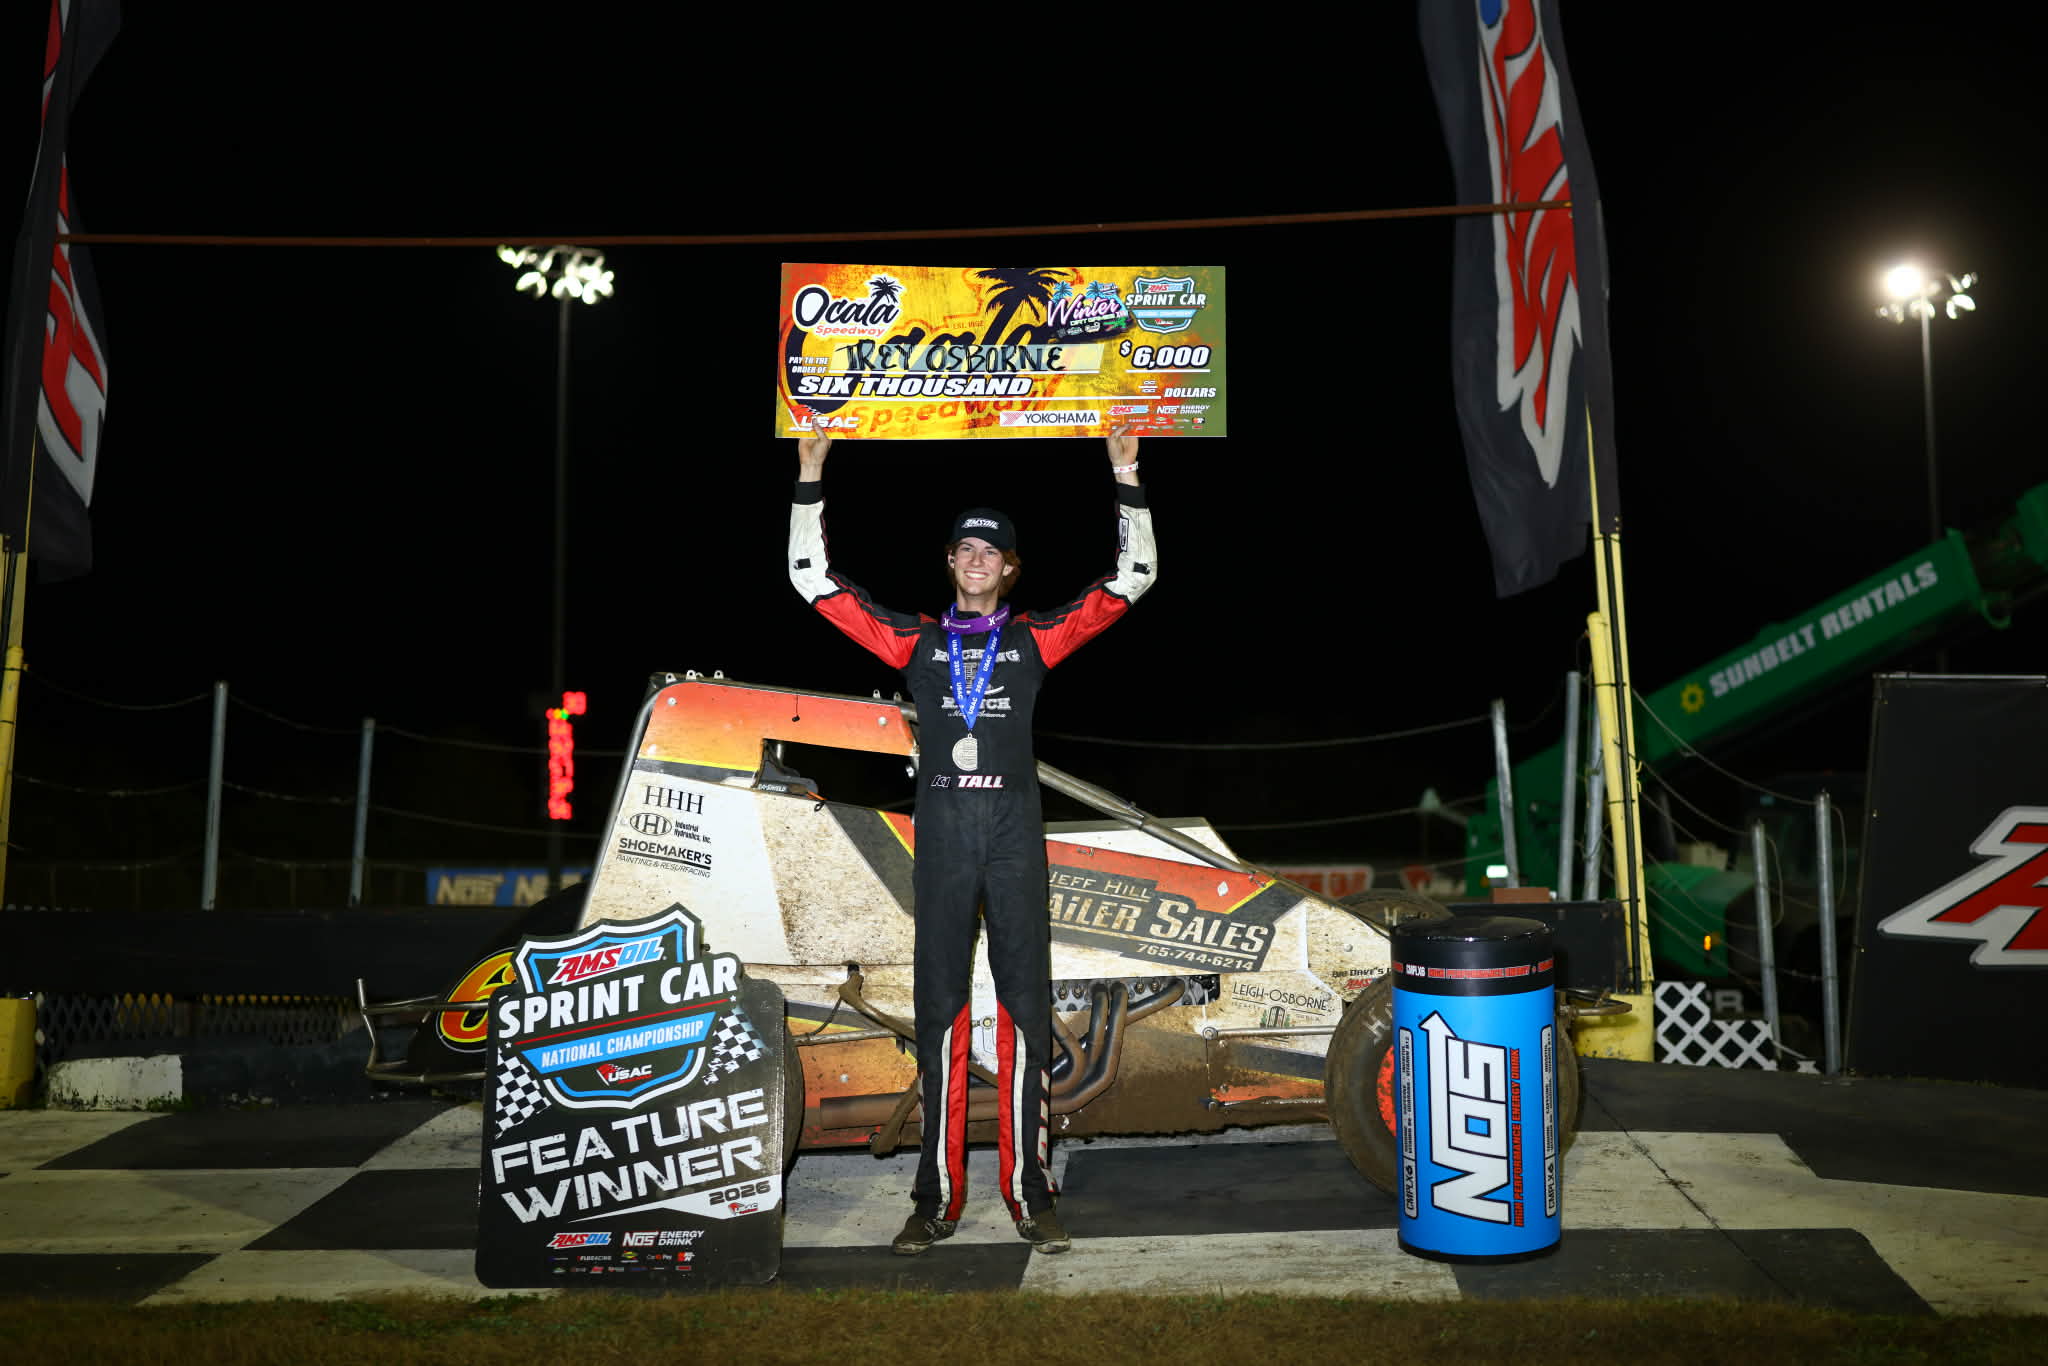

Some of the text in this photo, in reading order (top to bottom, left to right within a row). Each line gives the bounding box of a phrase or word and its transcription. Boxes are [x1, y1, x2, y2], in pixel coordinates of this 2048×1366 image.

[795, 286, 900, 327] Ocala
[1047, 293, 1120, 327] Winter
[1126, 293, 1206, 306] SPRINT CAR
[815, 324, 886, 337] Speedway
[834, 338, 1066, 374] TREY OSBORNE
[817, 366, 828, 374] OF
[797, 375, 1033, 397] SIX THOUSAND
[1163, 387, 1217, 398] DOLLARS
[1024, 412, 1097, 424] YOKOHAMA
[1156, 405, 1180, 414] NOS
[1709, 561, 1939, 698] SUNBELT RENTALS
[957, 775, 1004, 789] TALL
[642, 785, 705, 815] HHH
[675, 820, 699, 832] Industrial
[618, 837, 712, 866] SHOEMAKER'S
[615, 854, 652, 867] PAINTING
[659, 862, 711, 879] RESURFACING
[1049, 871, 1097, 889] JEFF
[548, 935, 664, 986] AMSOIL
[498, 956, 739, 1040] SPRINT CAR
[1231, 980, 1330, 1011] LEIGH-OSBORNE
[540, 1019, 704, 1069] NATIONAL CHAMPIONSHIP
[607, 1064, 653, 1082] USAC
[1418, 1010, 1513, 1226] NOS
[491, 1087, 769, 1184] FEATURE
[1509, 1047, 1525, 1228] HIGH PERFORMANCE ENERGY DRINK
[501, 1135, 765, 1224] WINNER
[708, 1180, 771, 1206] 2026
[546, 1231, 613, 1249] AMSOIL
[622, 1231, 659, 1247] NOS
[657, 1238, 693, 1246] DRINK
[659, 1230, 705, 1239] ENERGY
